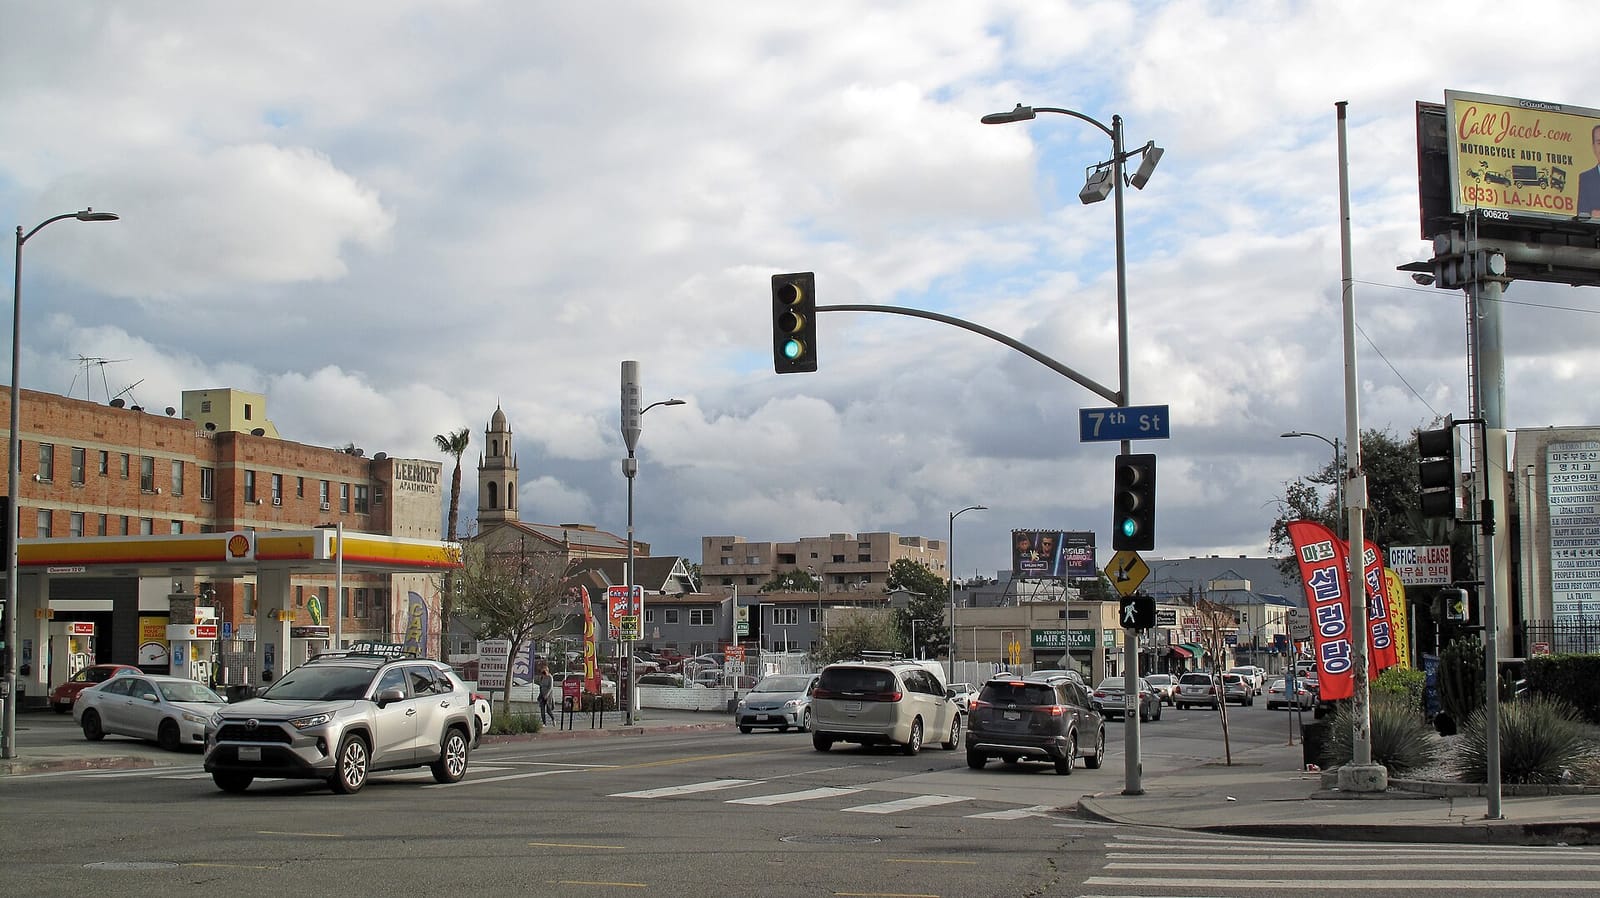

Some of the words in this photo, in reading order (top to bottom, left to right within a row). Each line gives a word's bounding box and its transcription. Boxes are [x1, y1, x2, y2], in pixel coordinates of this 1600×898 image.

[1459, 106, 1496, 140] Call
[1460, 142, 1516, 158] MOTORCYCLE
[1520, 150, 1542, 162] AUTO
[1546, 153, 1574, 166] TRUCK
[1463, 185, 1498, 205] (833)
[1503, 190, 1574, 210] LA-JACOB
[1483, 209, 1510, 220] 006212
[1088, 412, 1126, 437] 7th
[1139, 414, 1160, 431] St
[1552, 452, 1596, 460] 미주부동산
[396, 463, 440, 484] LEEMONT
[400, 482, 434, 494] APARTMENTS
[1301, 540, 1335, 563] 마포
[1392, 550, 1416, 565] OFFICE
[1417, 556, 1426, 564] FOR
[1427, 548, 1450, 564] LEASE
[1395, 566, 1424, 577] 사무실
[1428, 566, 1448, 576] 임대
[1308, 566, 1352, 674] 설렁탕
[348, 643, 371, 654] CAR
[374, 644, 404, 656] WAS
